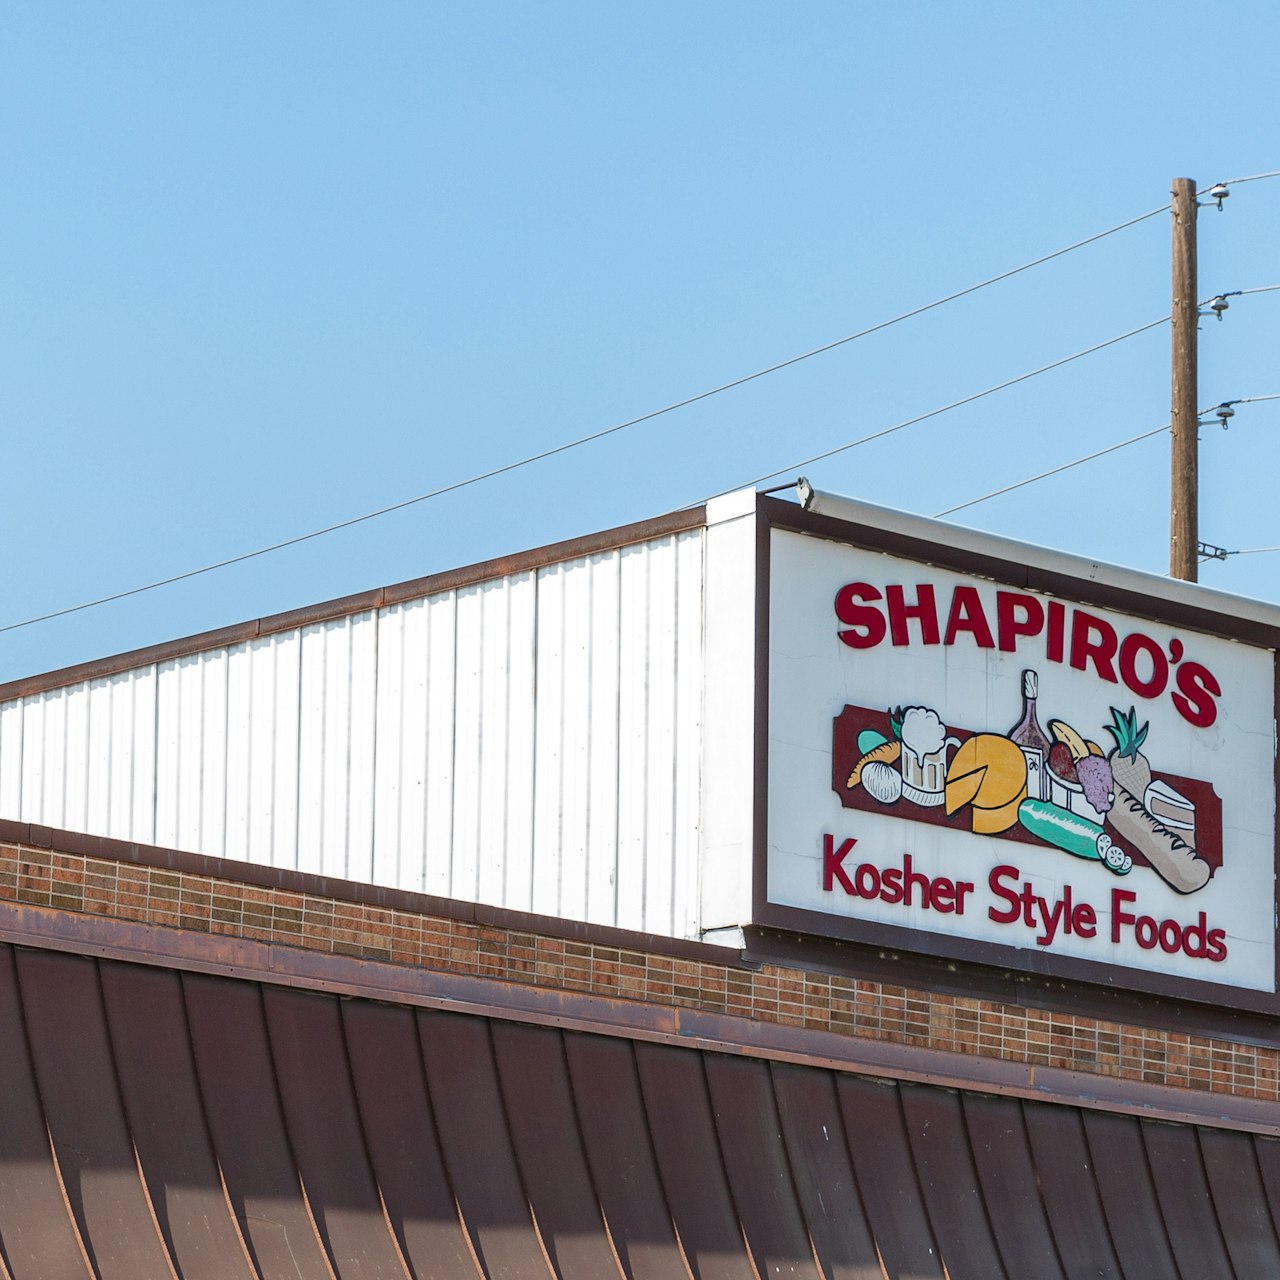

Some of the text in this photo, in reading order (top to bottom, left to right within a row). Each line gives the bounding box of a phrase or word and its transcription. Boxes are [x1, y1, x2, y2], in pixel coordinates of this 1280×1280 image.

[834, 580, 1222, 728] SHAPIRO'S
[822, 833, 1228, 963] Kosher Style Foods
